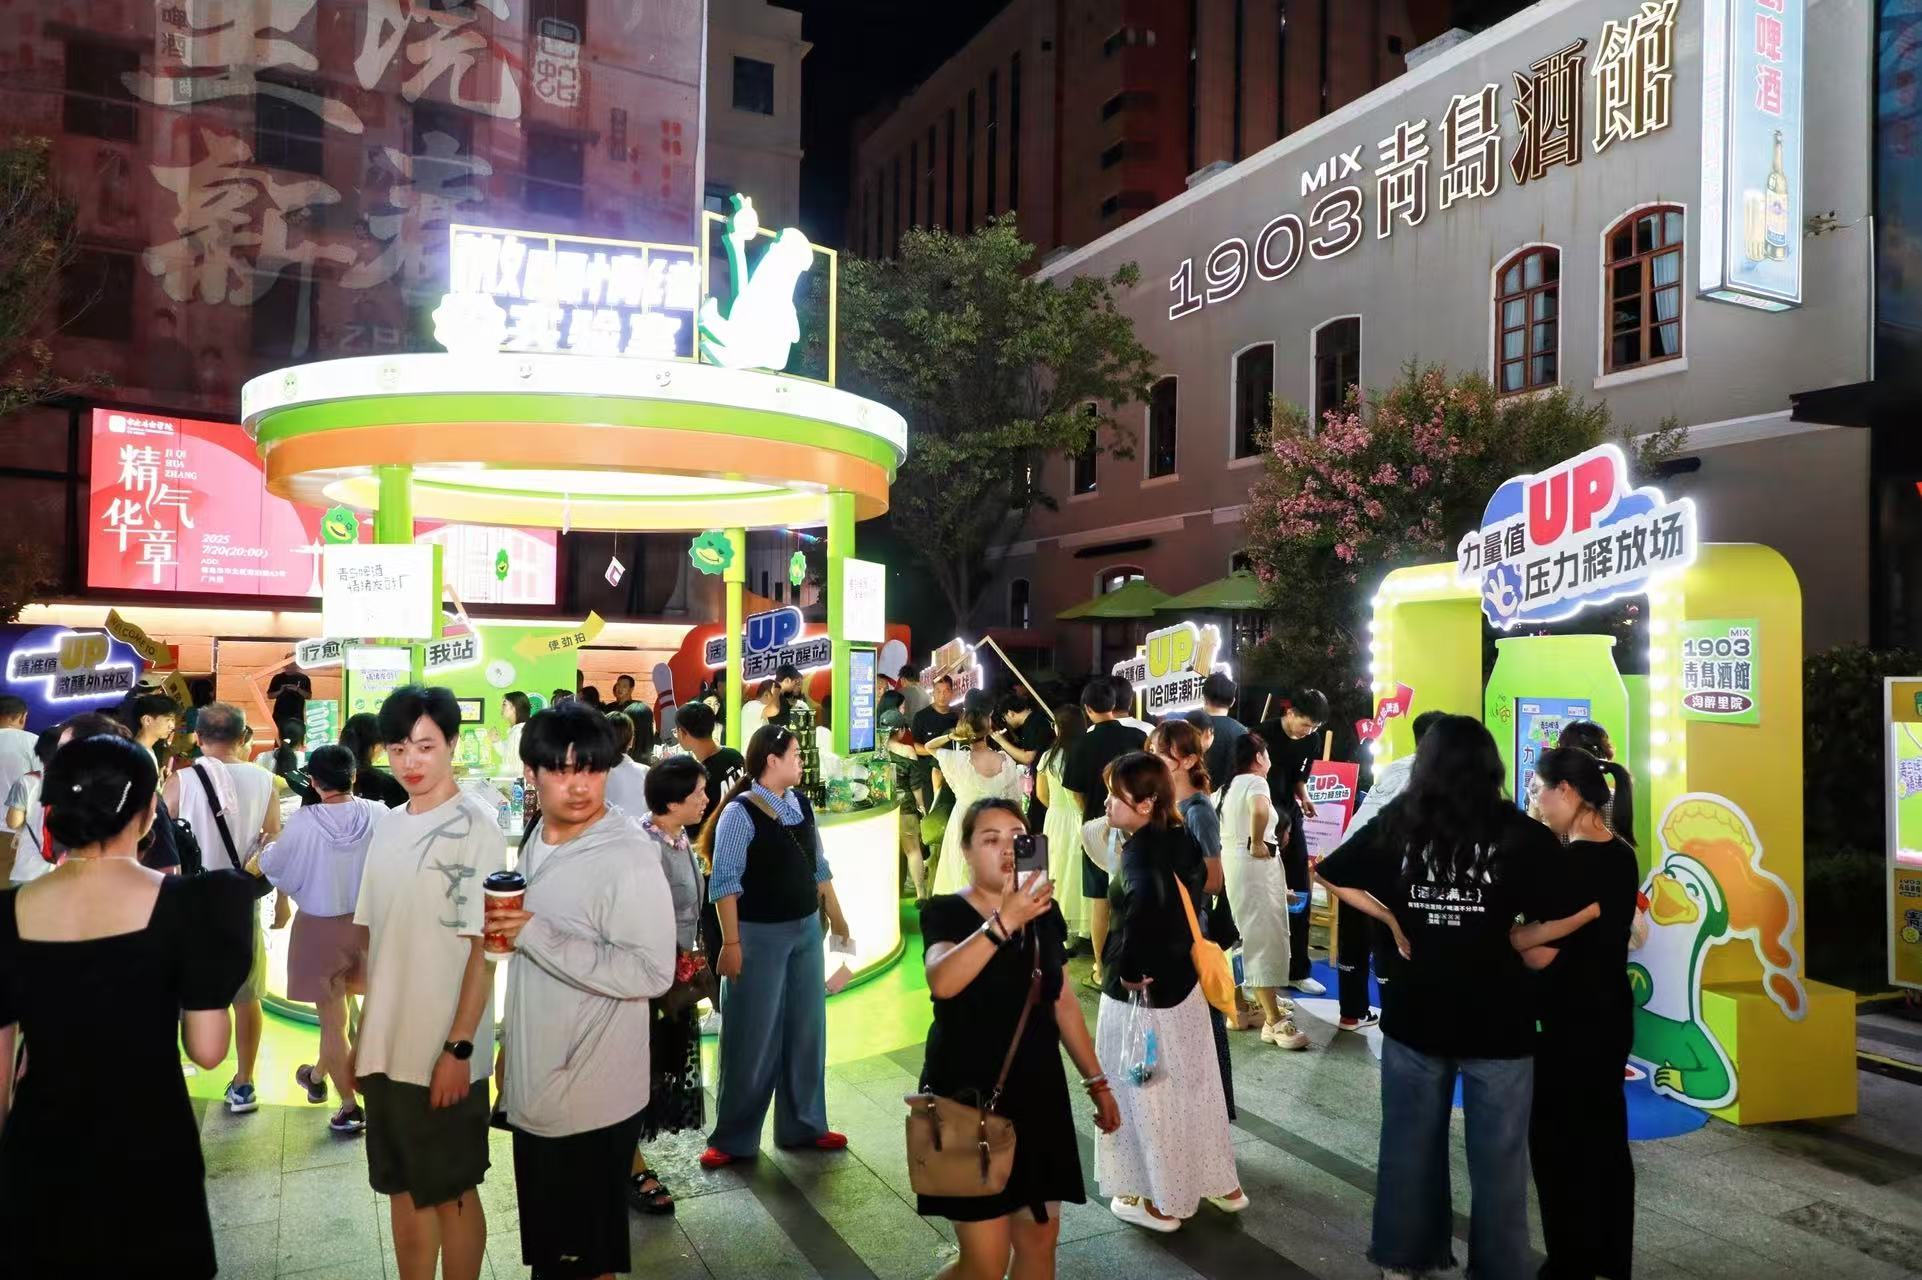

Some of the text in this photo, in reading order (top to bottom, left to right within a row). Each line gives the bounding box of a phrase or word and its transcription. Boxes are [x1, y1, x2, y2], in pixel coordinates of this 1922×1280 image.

[1301, 144, 1363, 197] MIX
[1169, 184, 1363, 321] 1903
[164, 470, 198, 480] ZHANG
[1528, 456, 1616, 546] UP
[1462, 522, 1526, 573] 力量值
[1524, 511, 1685, 602] 压力释放场
[548, 632, 587, 651] 使劲拍
[748, 611, 798, 652] UP
[1684, 639, 1750, 657] 1903
[1729, 629, 1750, 637] MIX
[61, 638, 108, 671] UP
[423, 639, 474, 666] 我站
[747, 640, 829, 676] 活力觉醒站
[1148, 628, 1194, 677] UP
[1316, 776, 1337, 790] UP
